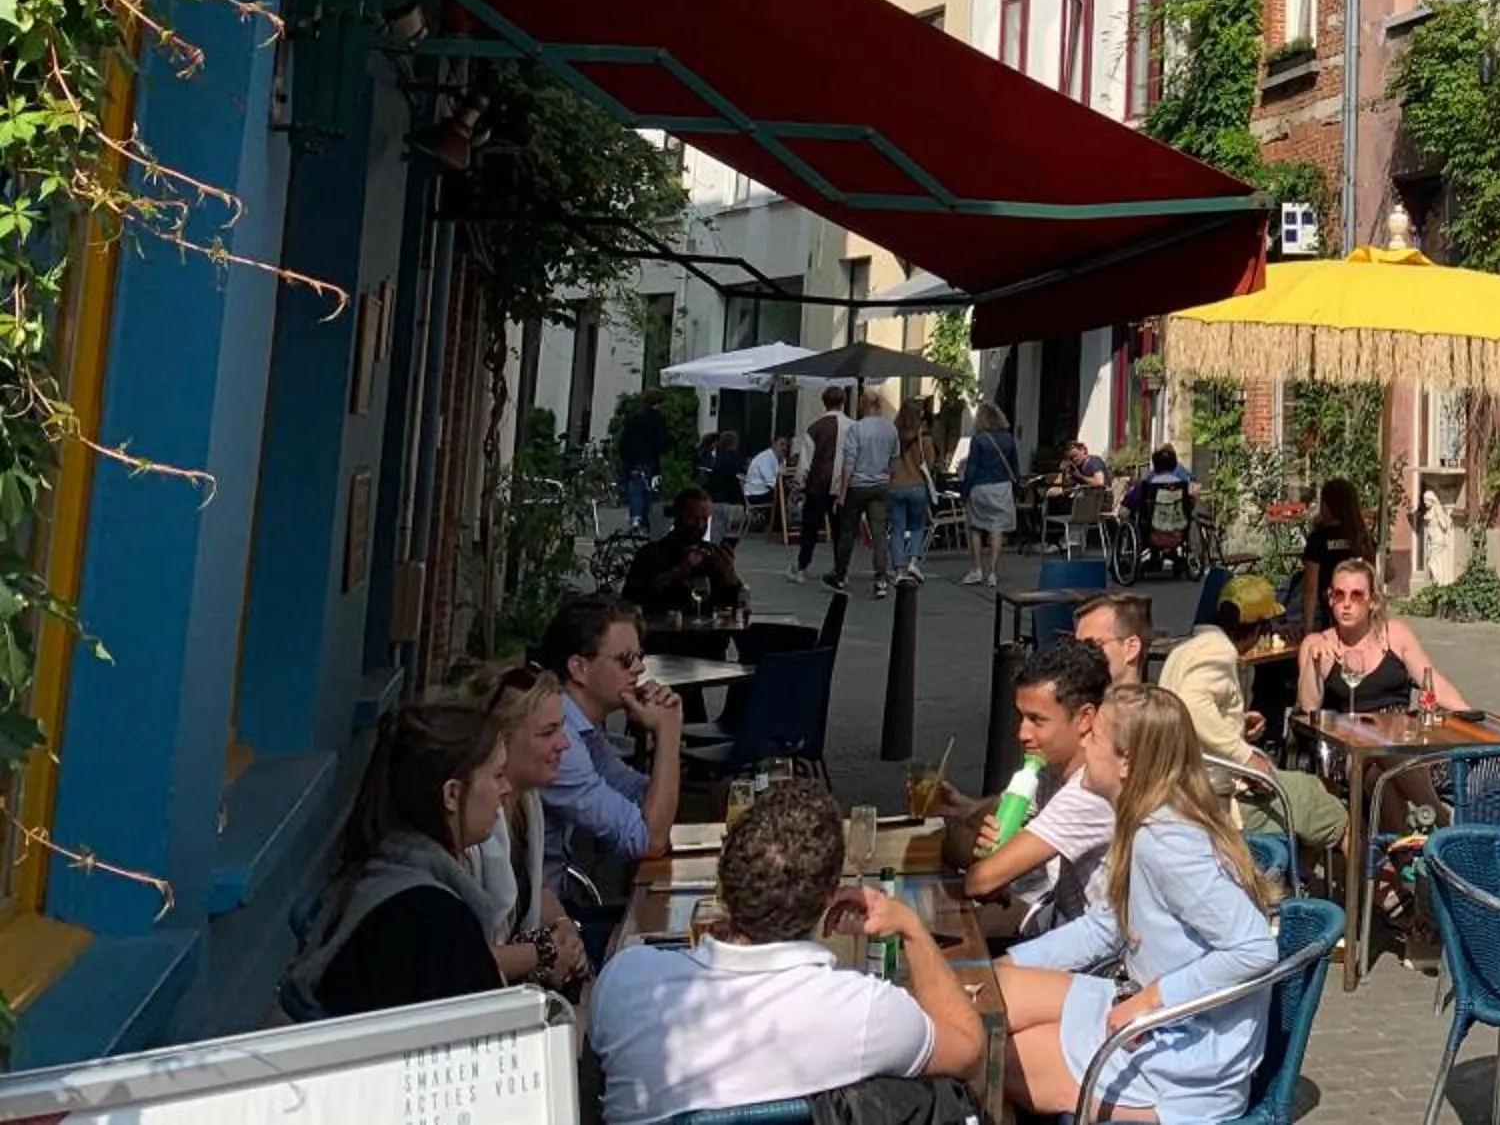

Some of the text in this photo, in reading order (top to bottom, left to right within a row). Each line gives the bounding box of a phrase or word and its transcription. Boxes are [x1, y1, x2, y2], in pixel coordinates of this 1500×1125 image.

[403, 1053, 519, 1093] SMAKEN EN
[403, 1071, 541, 1117] ACTIES VOLG
